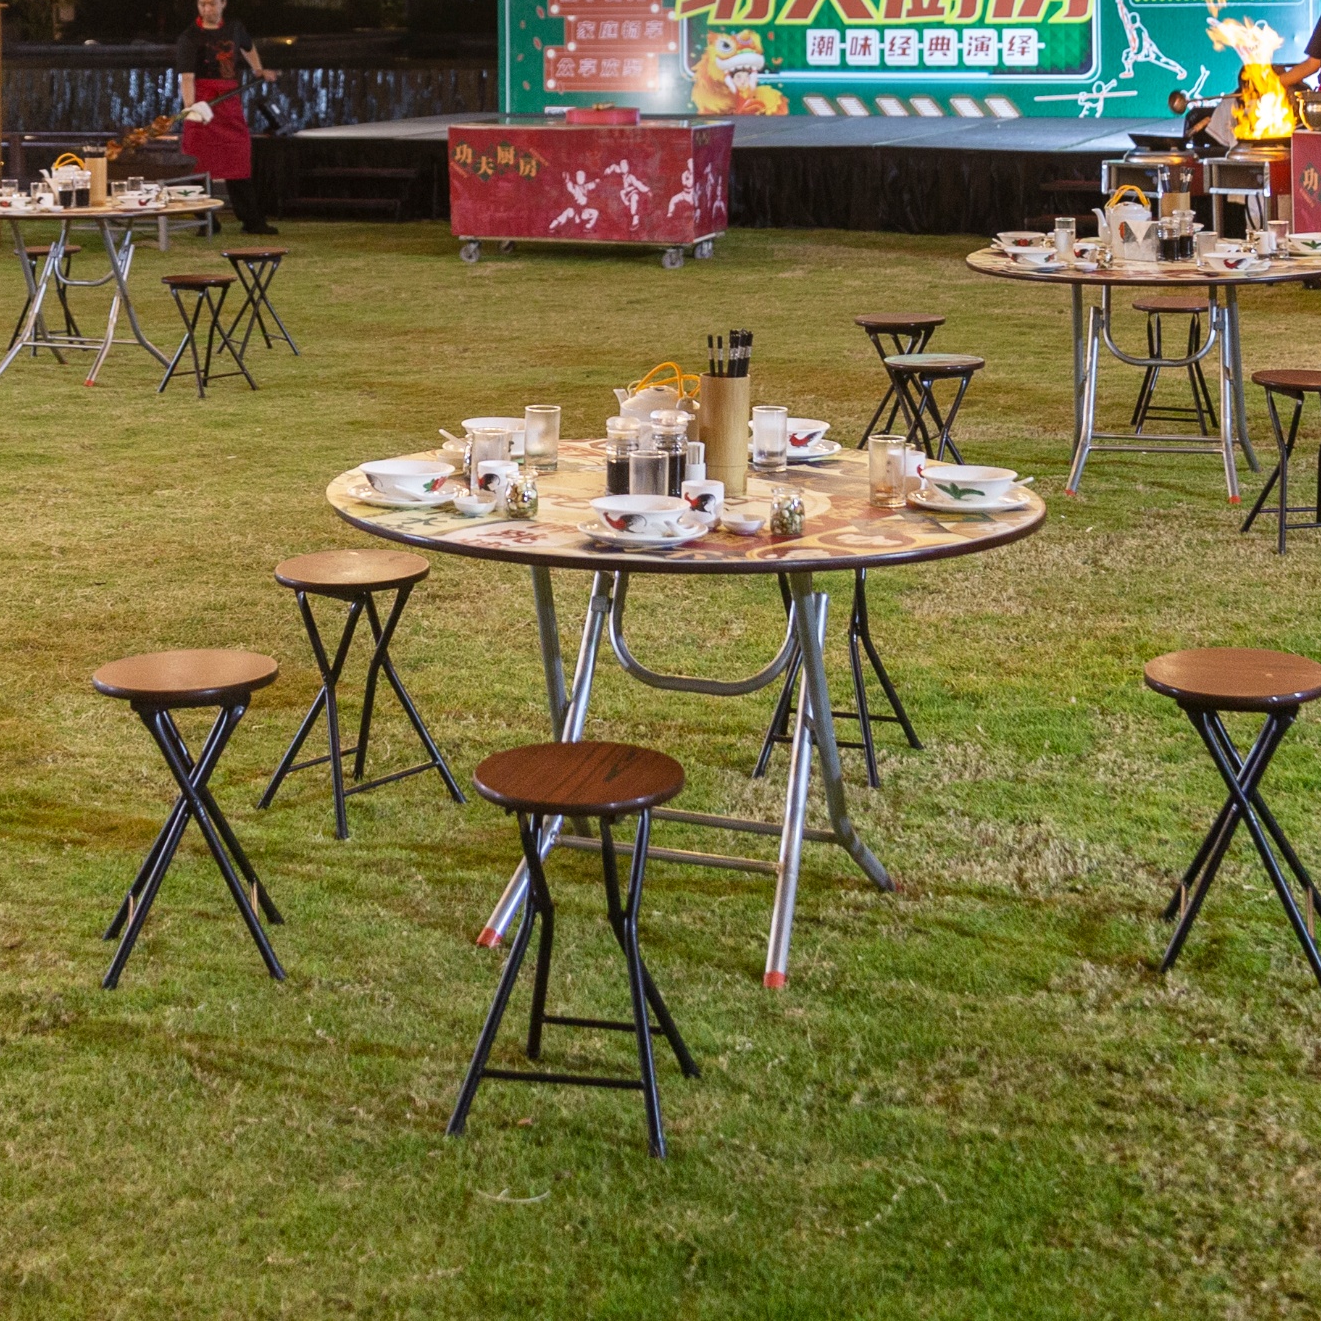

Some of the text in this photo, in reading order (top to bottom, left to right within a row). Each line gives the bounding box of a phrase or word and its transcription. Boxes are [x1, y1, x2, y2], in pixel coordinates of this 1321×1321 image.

[810, 35, 1032, 57] 潮味经典演绎
[454, 143, 539, 177] 功夫厨房
